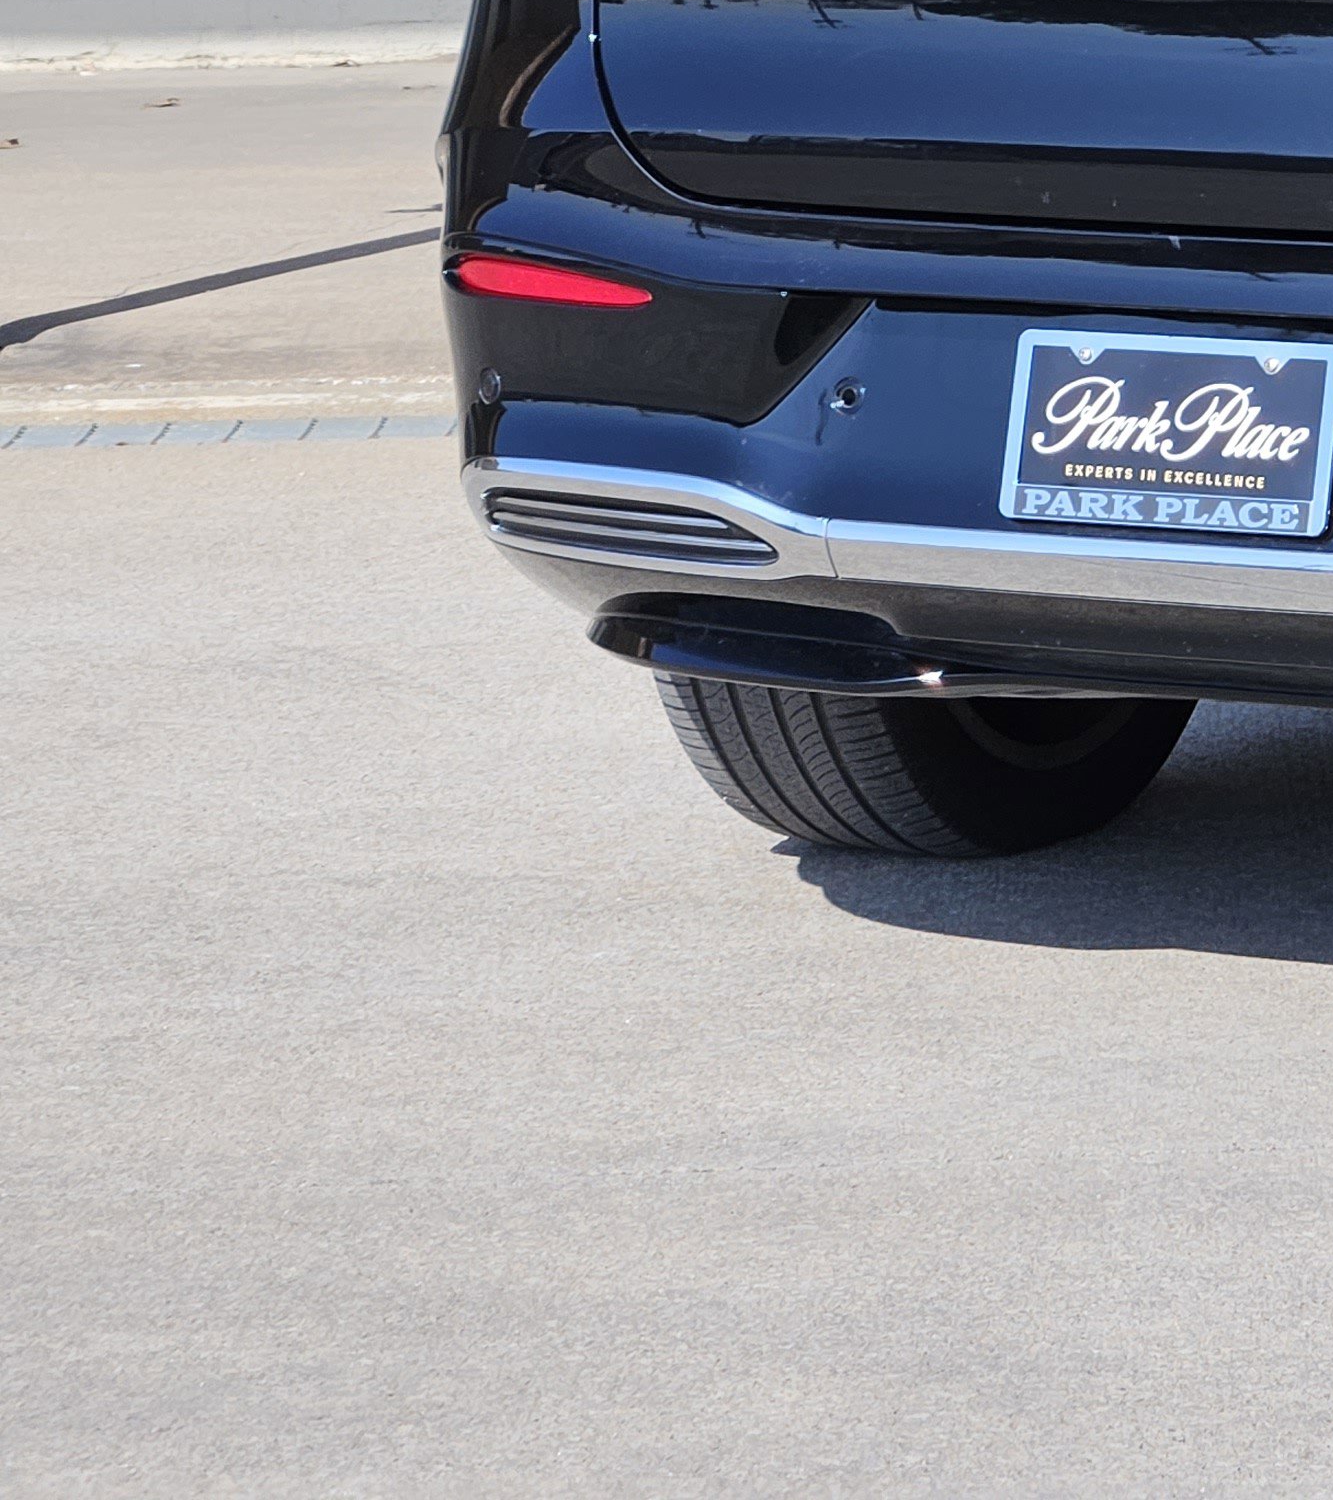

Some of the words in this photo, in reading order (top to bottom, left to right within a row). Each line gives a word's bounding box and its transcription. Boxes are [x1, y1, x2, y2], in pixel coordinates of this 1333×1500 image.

[1031, 375, 1171, 454] Park
[1160, 382, 1310, 462] Place
[1064, 463, 1133, 481] EXPERTS
[1140, 469, 1158, 484] IN
[1163, 471, 1266, 490] EXCELLENCE
[1021, 488, 1144, 522] PARK
[1153, 499, 1299, 531] PLACE
